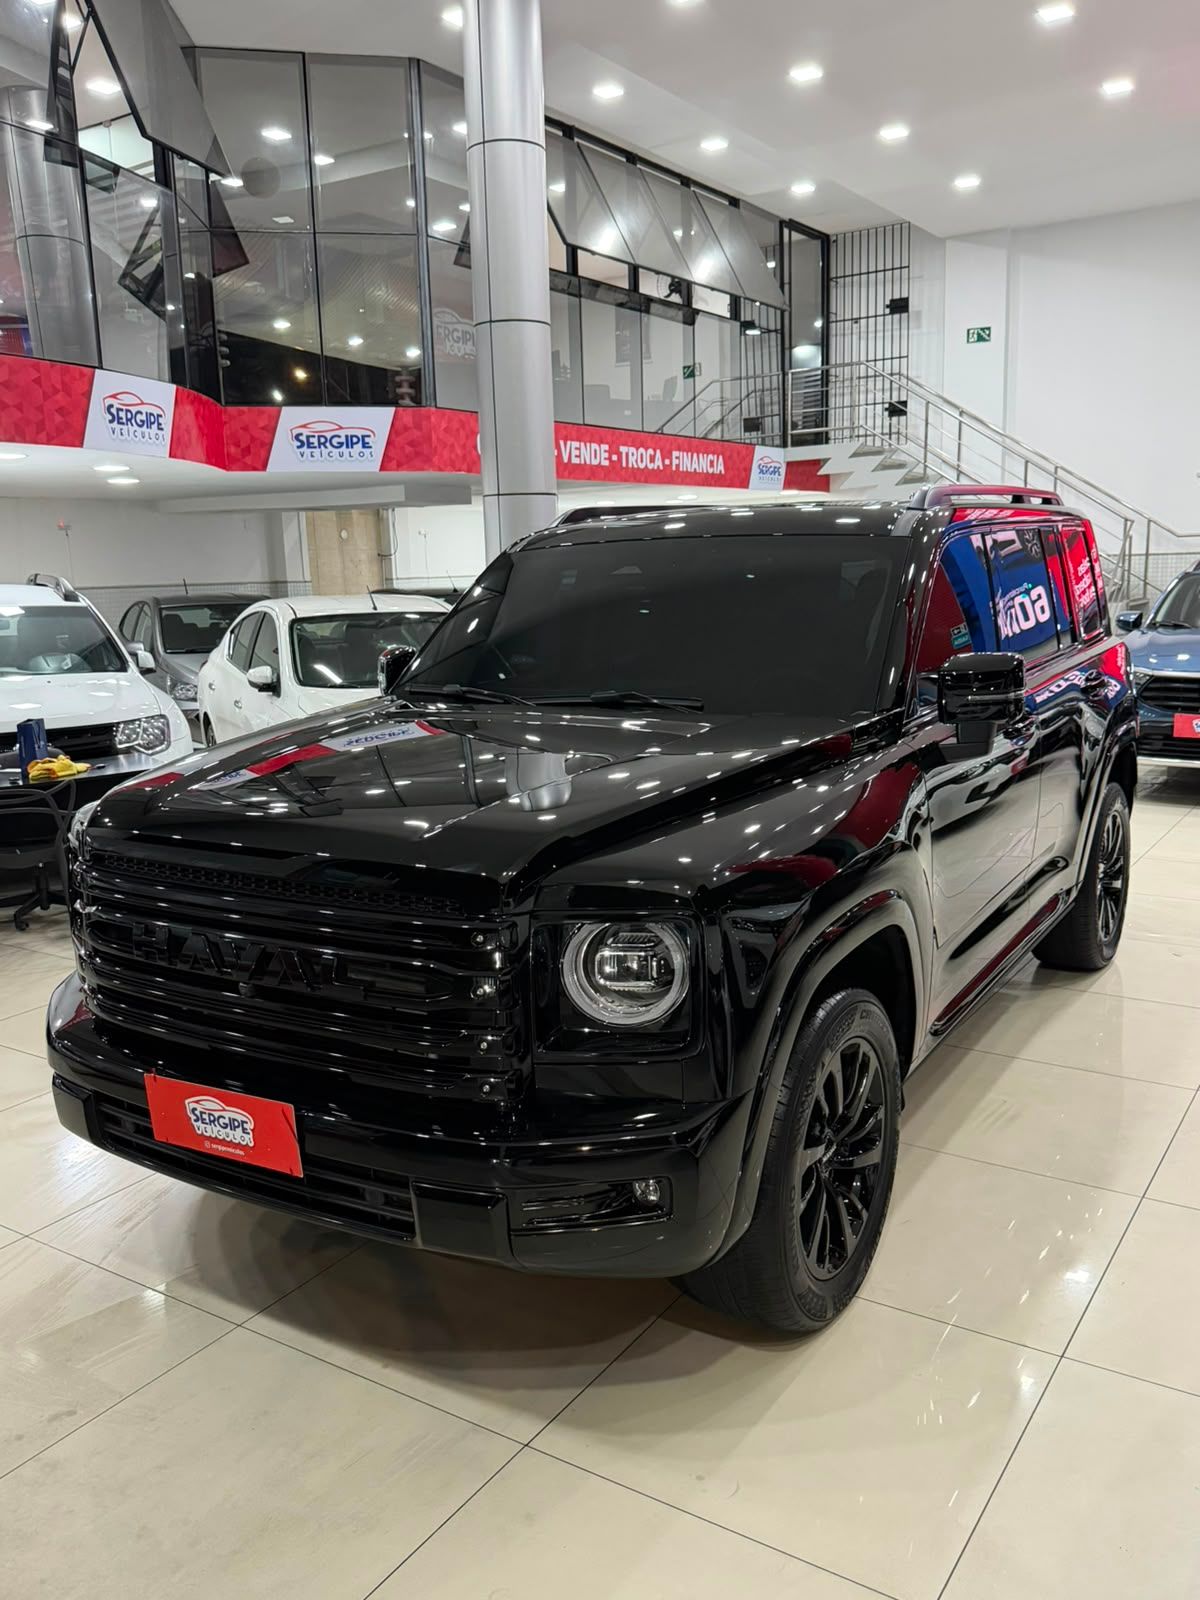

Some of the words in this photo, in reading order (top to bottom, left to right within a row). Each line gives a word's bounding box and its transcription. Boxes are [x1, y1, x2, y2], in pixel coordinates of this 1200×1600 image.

[106, 403, 164, 431] SERGIPE
[294, 432, 373, 449] SERGIPE
[559, 439, 609, 466] VENDE
[619, 445, 663, 470] TROCA
[672, 450, 725, 474] FINANCIA
[132, 921, 374, 1000] HAVAL
[191, 1107, 250, 1135] SERGIPE
